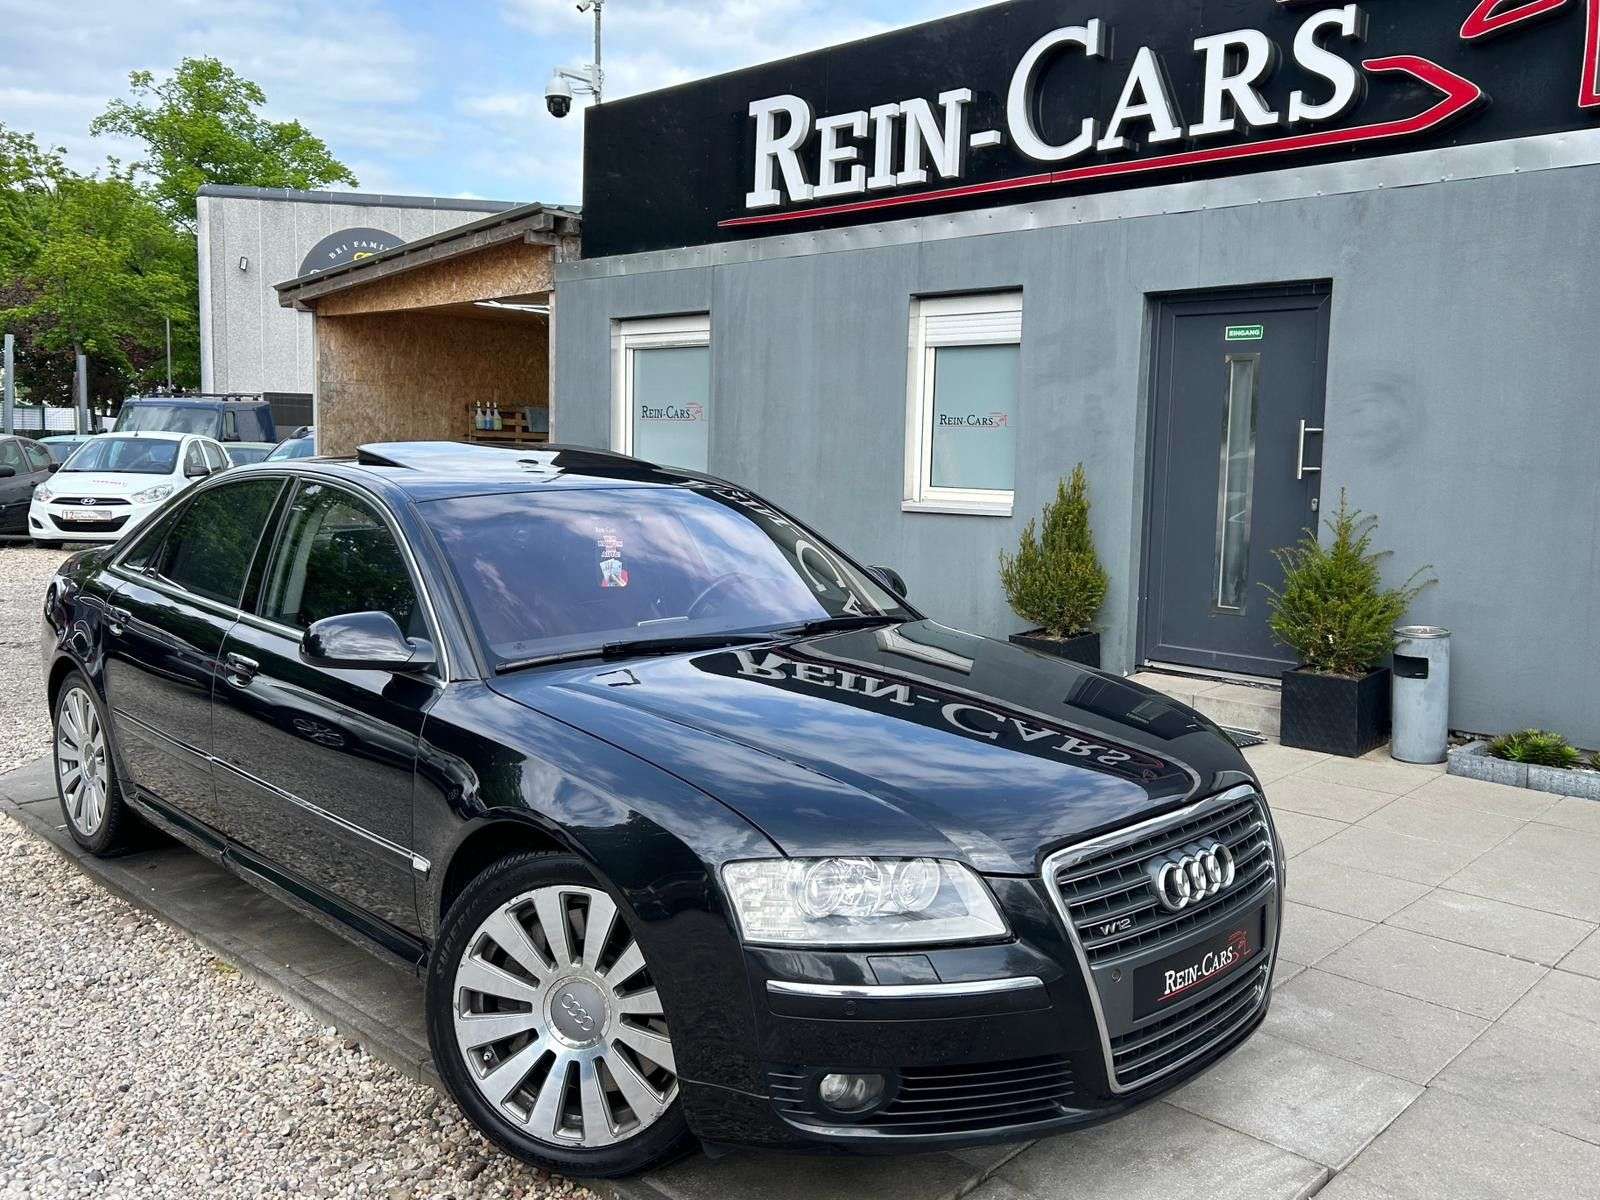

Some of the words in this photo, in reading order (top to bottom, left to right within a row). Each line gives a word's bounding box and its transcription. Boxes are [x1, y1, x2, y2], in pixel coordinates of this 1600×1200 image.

[745, 4, 1363, 209] REIN-CARS
[328, 244, 348, 260] BEI
[1228, 329, 1260, 337] EINGANG
[641, 405, 691, 419] REIN-CARS
[939, 414, 994, 426] REIN-CARS
[1099, 918, 1132, 936] W12
[1163, 945, 1234, 995] REIN-CARS
